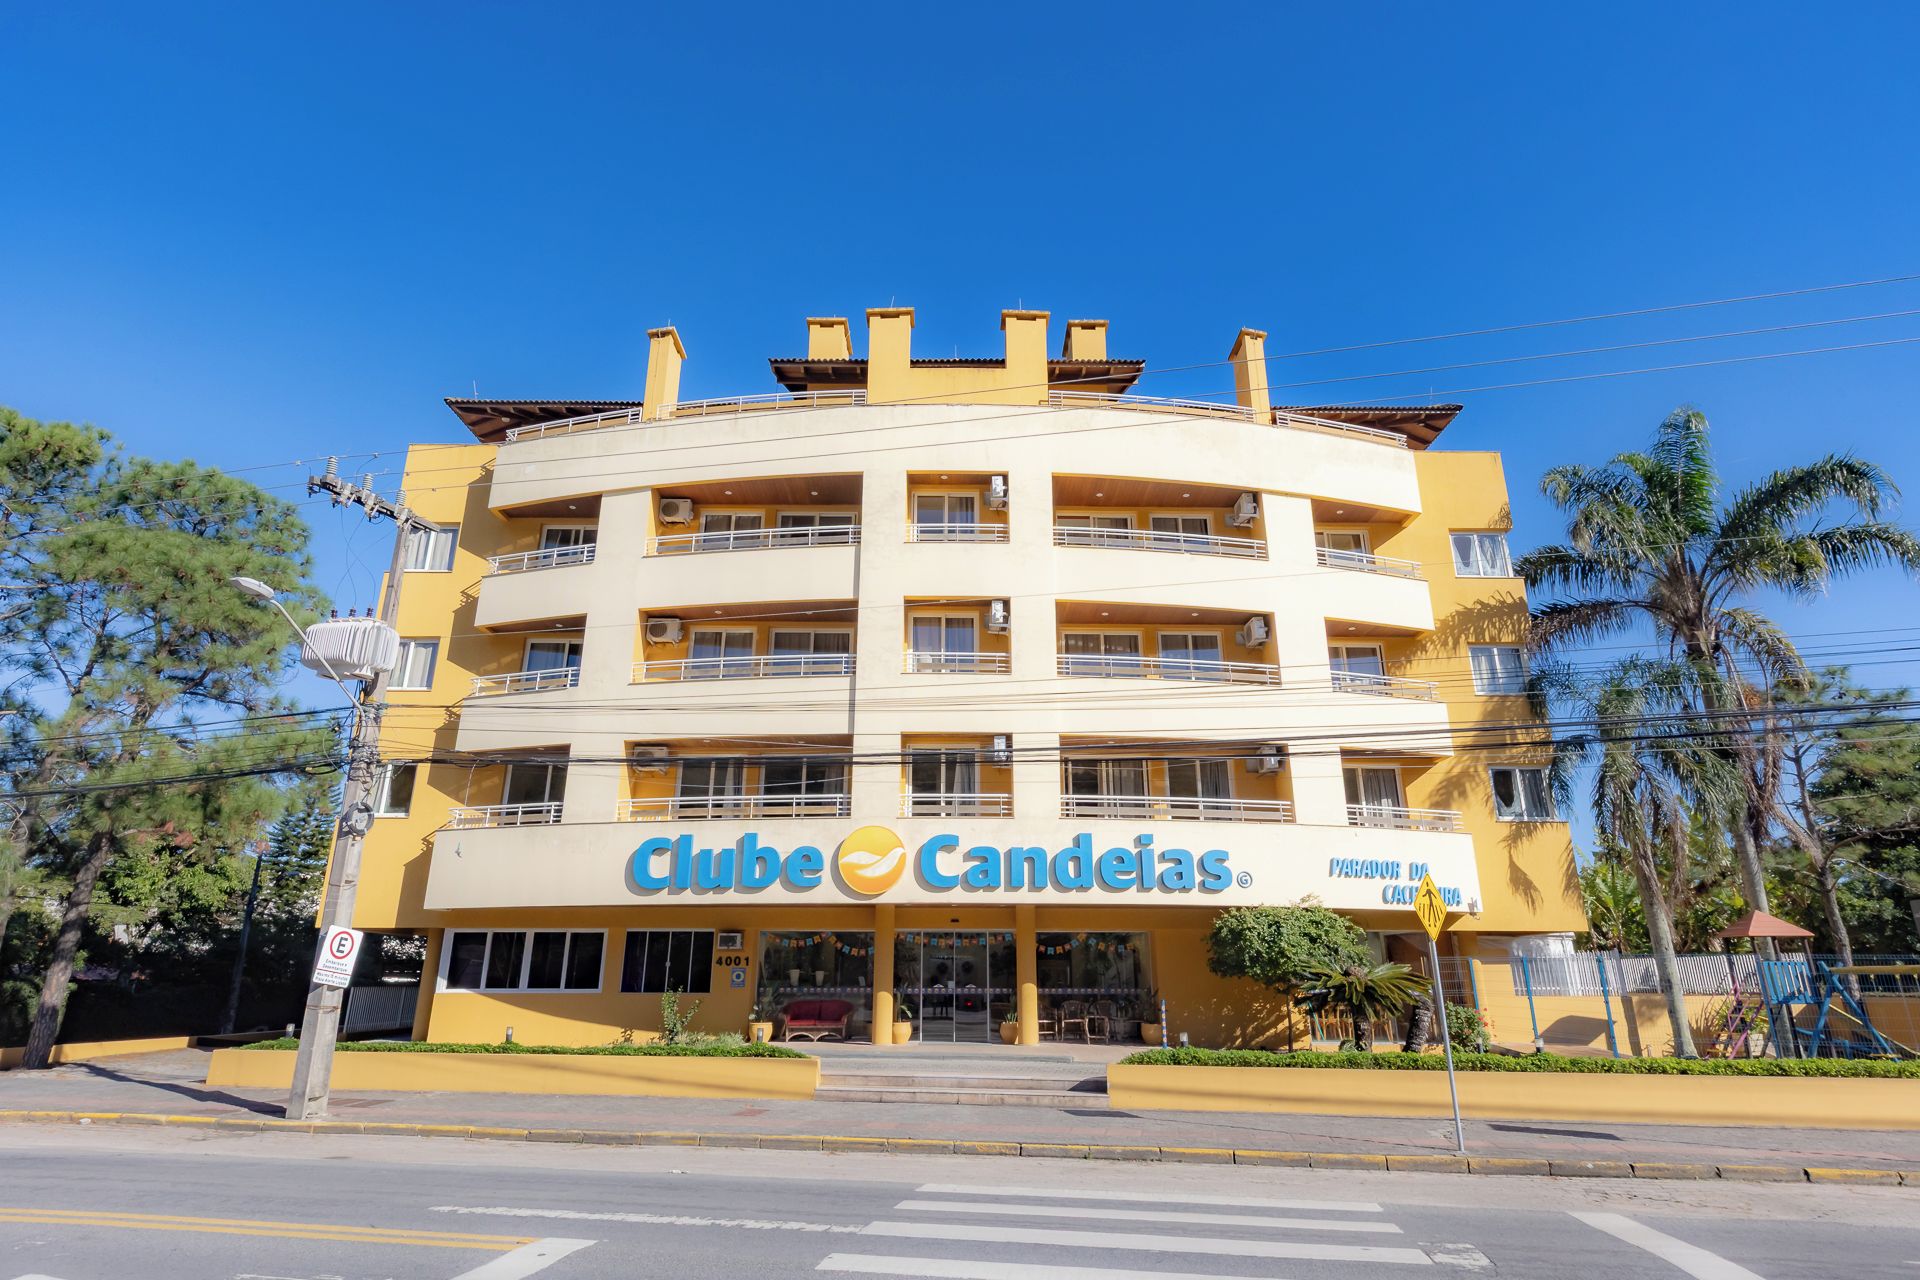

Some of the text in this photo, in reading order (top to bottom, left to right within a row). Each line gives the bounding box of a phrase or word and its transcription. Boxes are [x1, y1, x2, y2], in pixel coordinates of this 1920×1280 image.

[632, 832, 1233, 891] Clube Candeias
[1330, 857, 1401, 879] PARADOR
[336, 936, 348, 954] E
[716, 955, 750, 967] 4001
